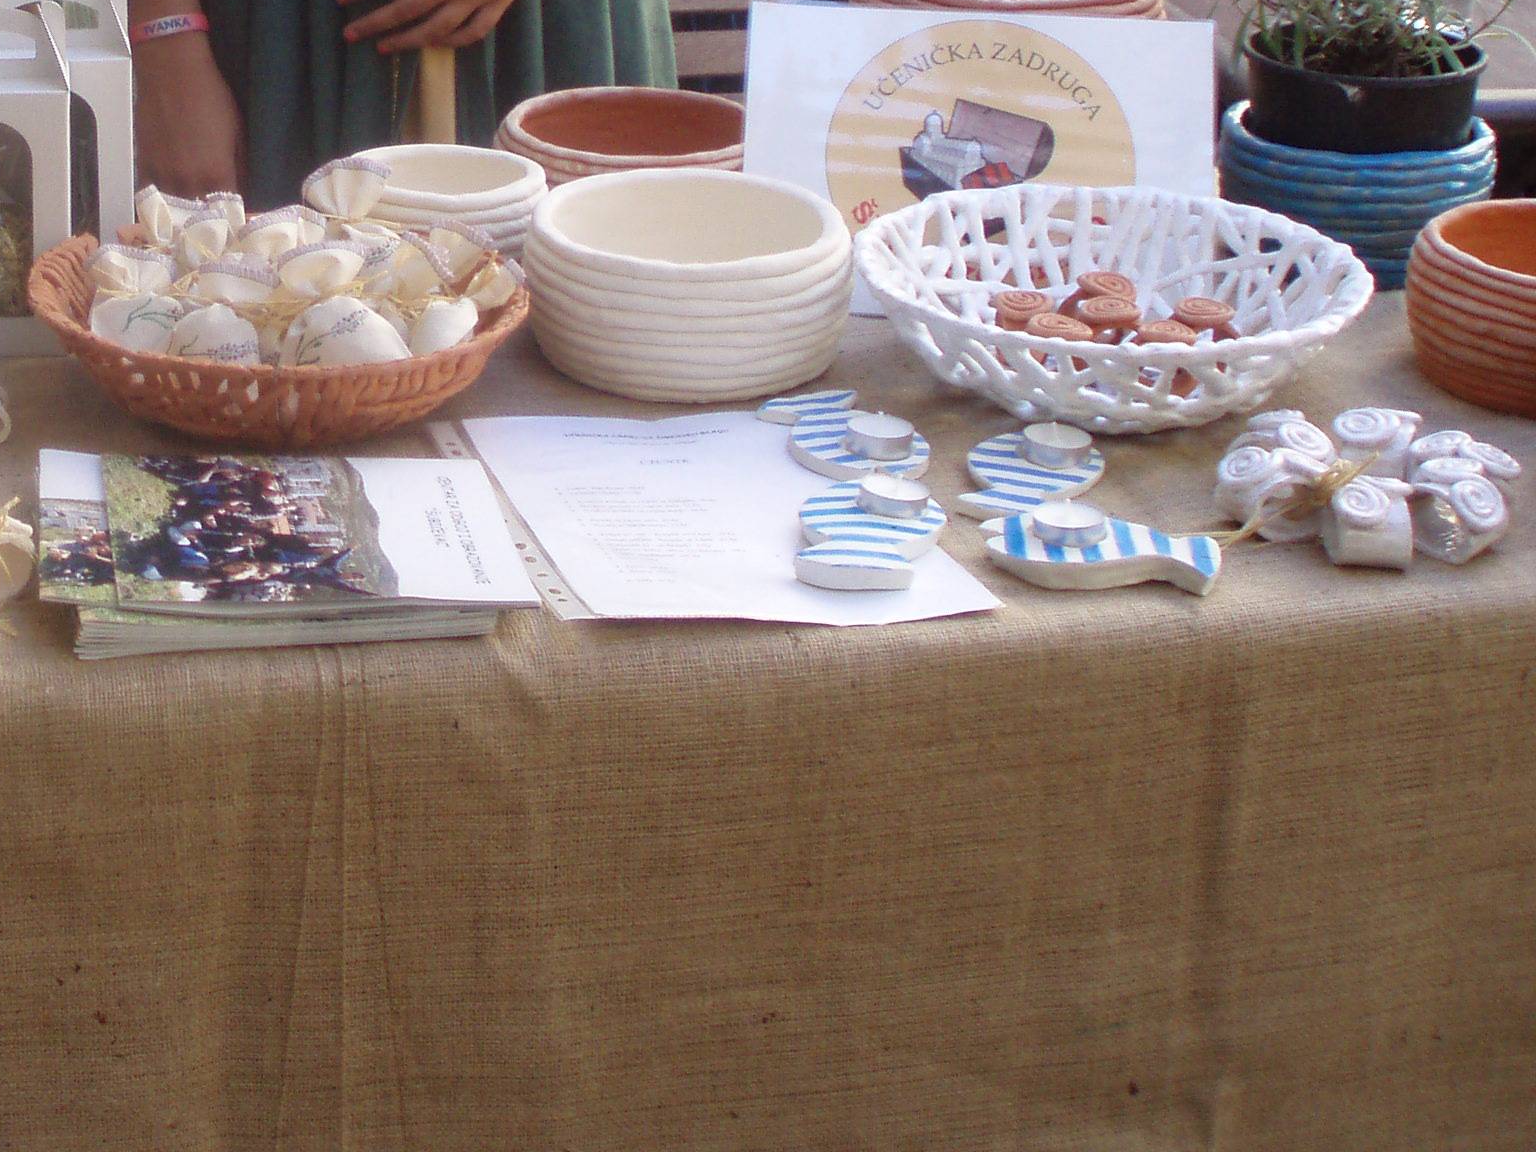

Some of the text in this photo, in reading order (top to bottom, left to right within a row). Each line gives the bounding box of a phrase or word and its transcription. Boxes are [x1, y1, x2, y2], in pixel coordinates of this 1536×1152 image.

[143, 16, 191, 35] IVANKA
[863, 41, 1101, 121] UČENIČKA ZADRUGA
